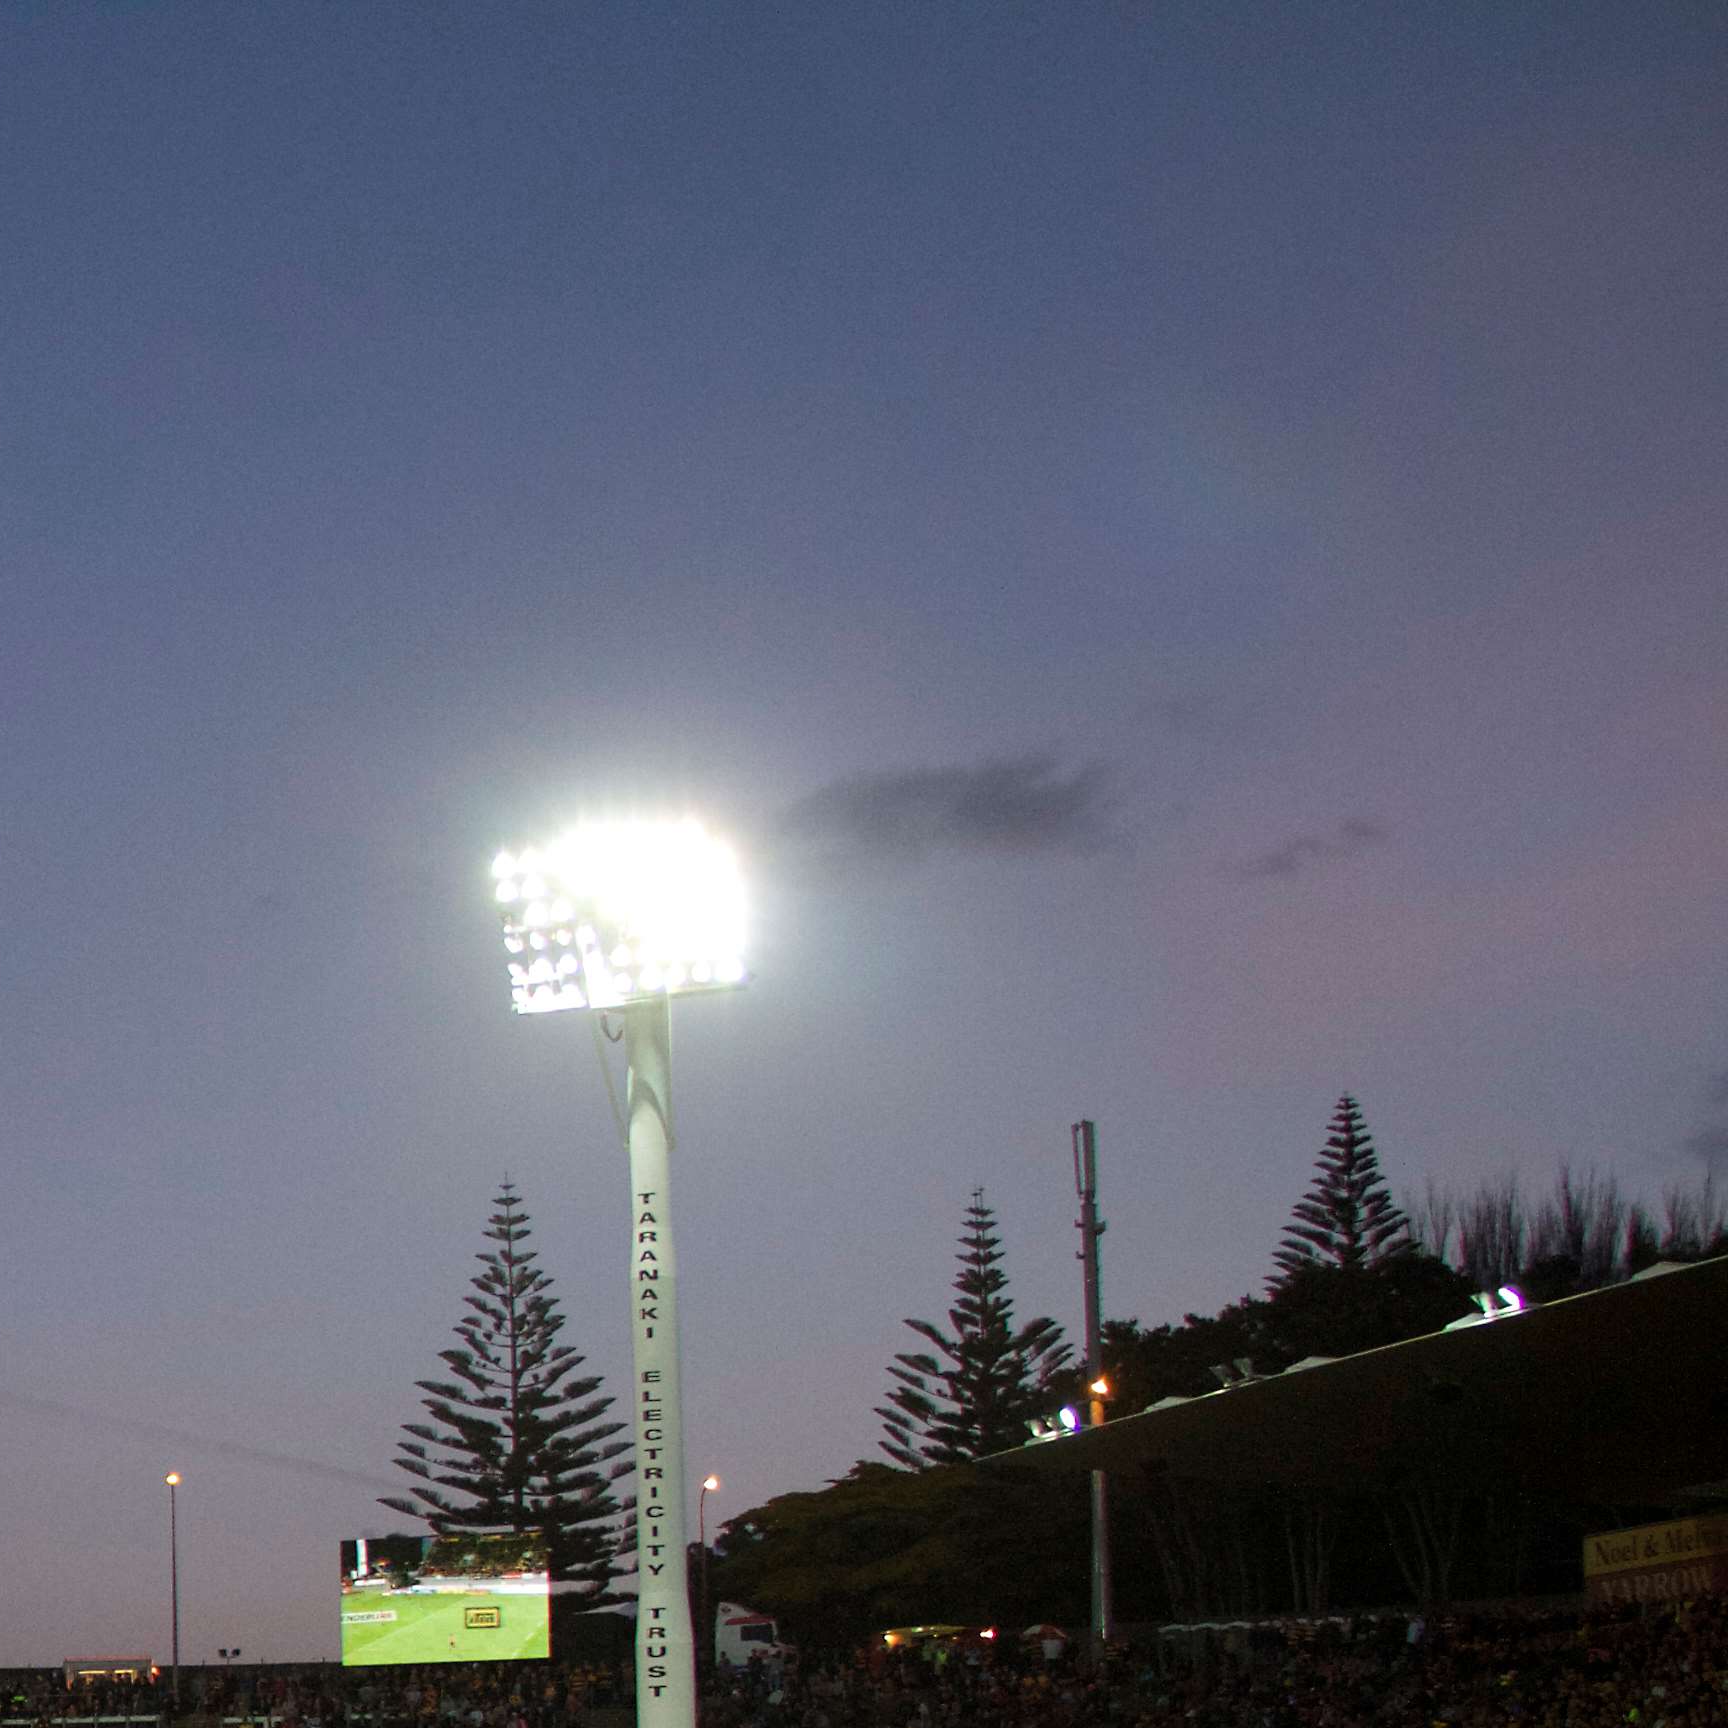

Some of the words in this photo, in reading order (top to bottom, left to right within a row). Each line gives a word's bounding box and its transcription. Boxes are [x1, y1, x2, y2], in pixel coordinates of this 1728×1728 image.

[637, 1191, 658, 1339] TARANAKI
[641, 1371, 664, 1576] ELECTRICITY
[648, 1608, 666, 1698] TRUST
